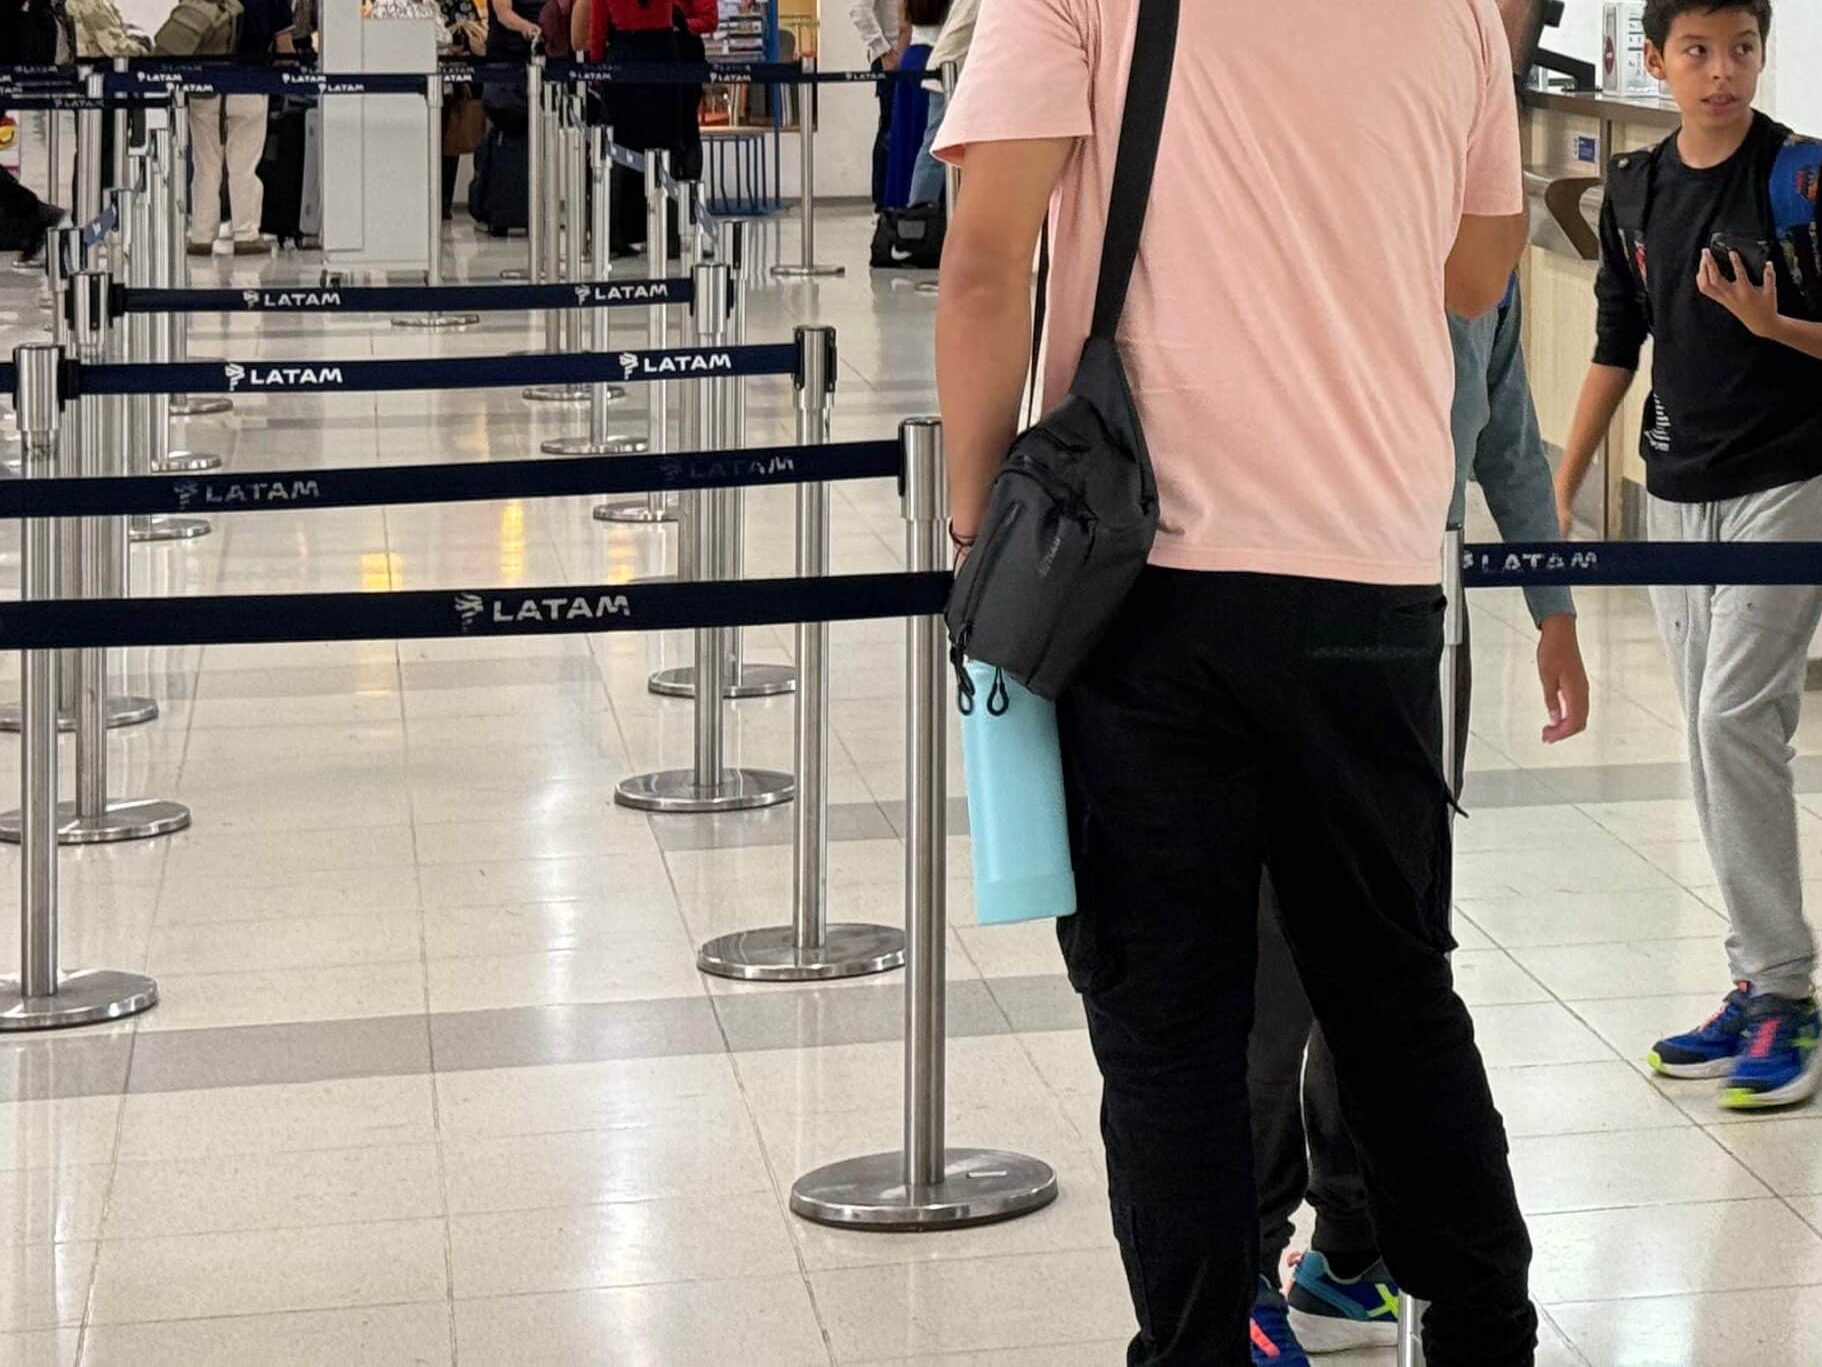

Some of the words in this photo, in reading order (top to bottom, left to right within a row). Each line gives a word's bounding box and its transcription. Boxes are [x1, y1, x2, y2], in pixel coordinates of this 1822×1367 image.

[146, 74, 183, 82] LATAM
[291, 75, 327, 83] LATAM
[717, 72, 751, 82] LATAM
[176, 83, 213, 92] LATAM
[327, 84, 364, 92] LATAM
[264, 291, 341, 307] LATAM
[595, 283, 669, 299] LATAM
[644, 353, 732, 373] LATAM
[250, 368, 343, 386] LATAM
[205, 479, 320, 503] LATAM
[493, 595, 631, 622] LATAM
